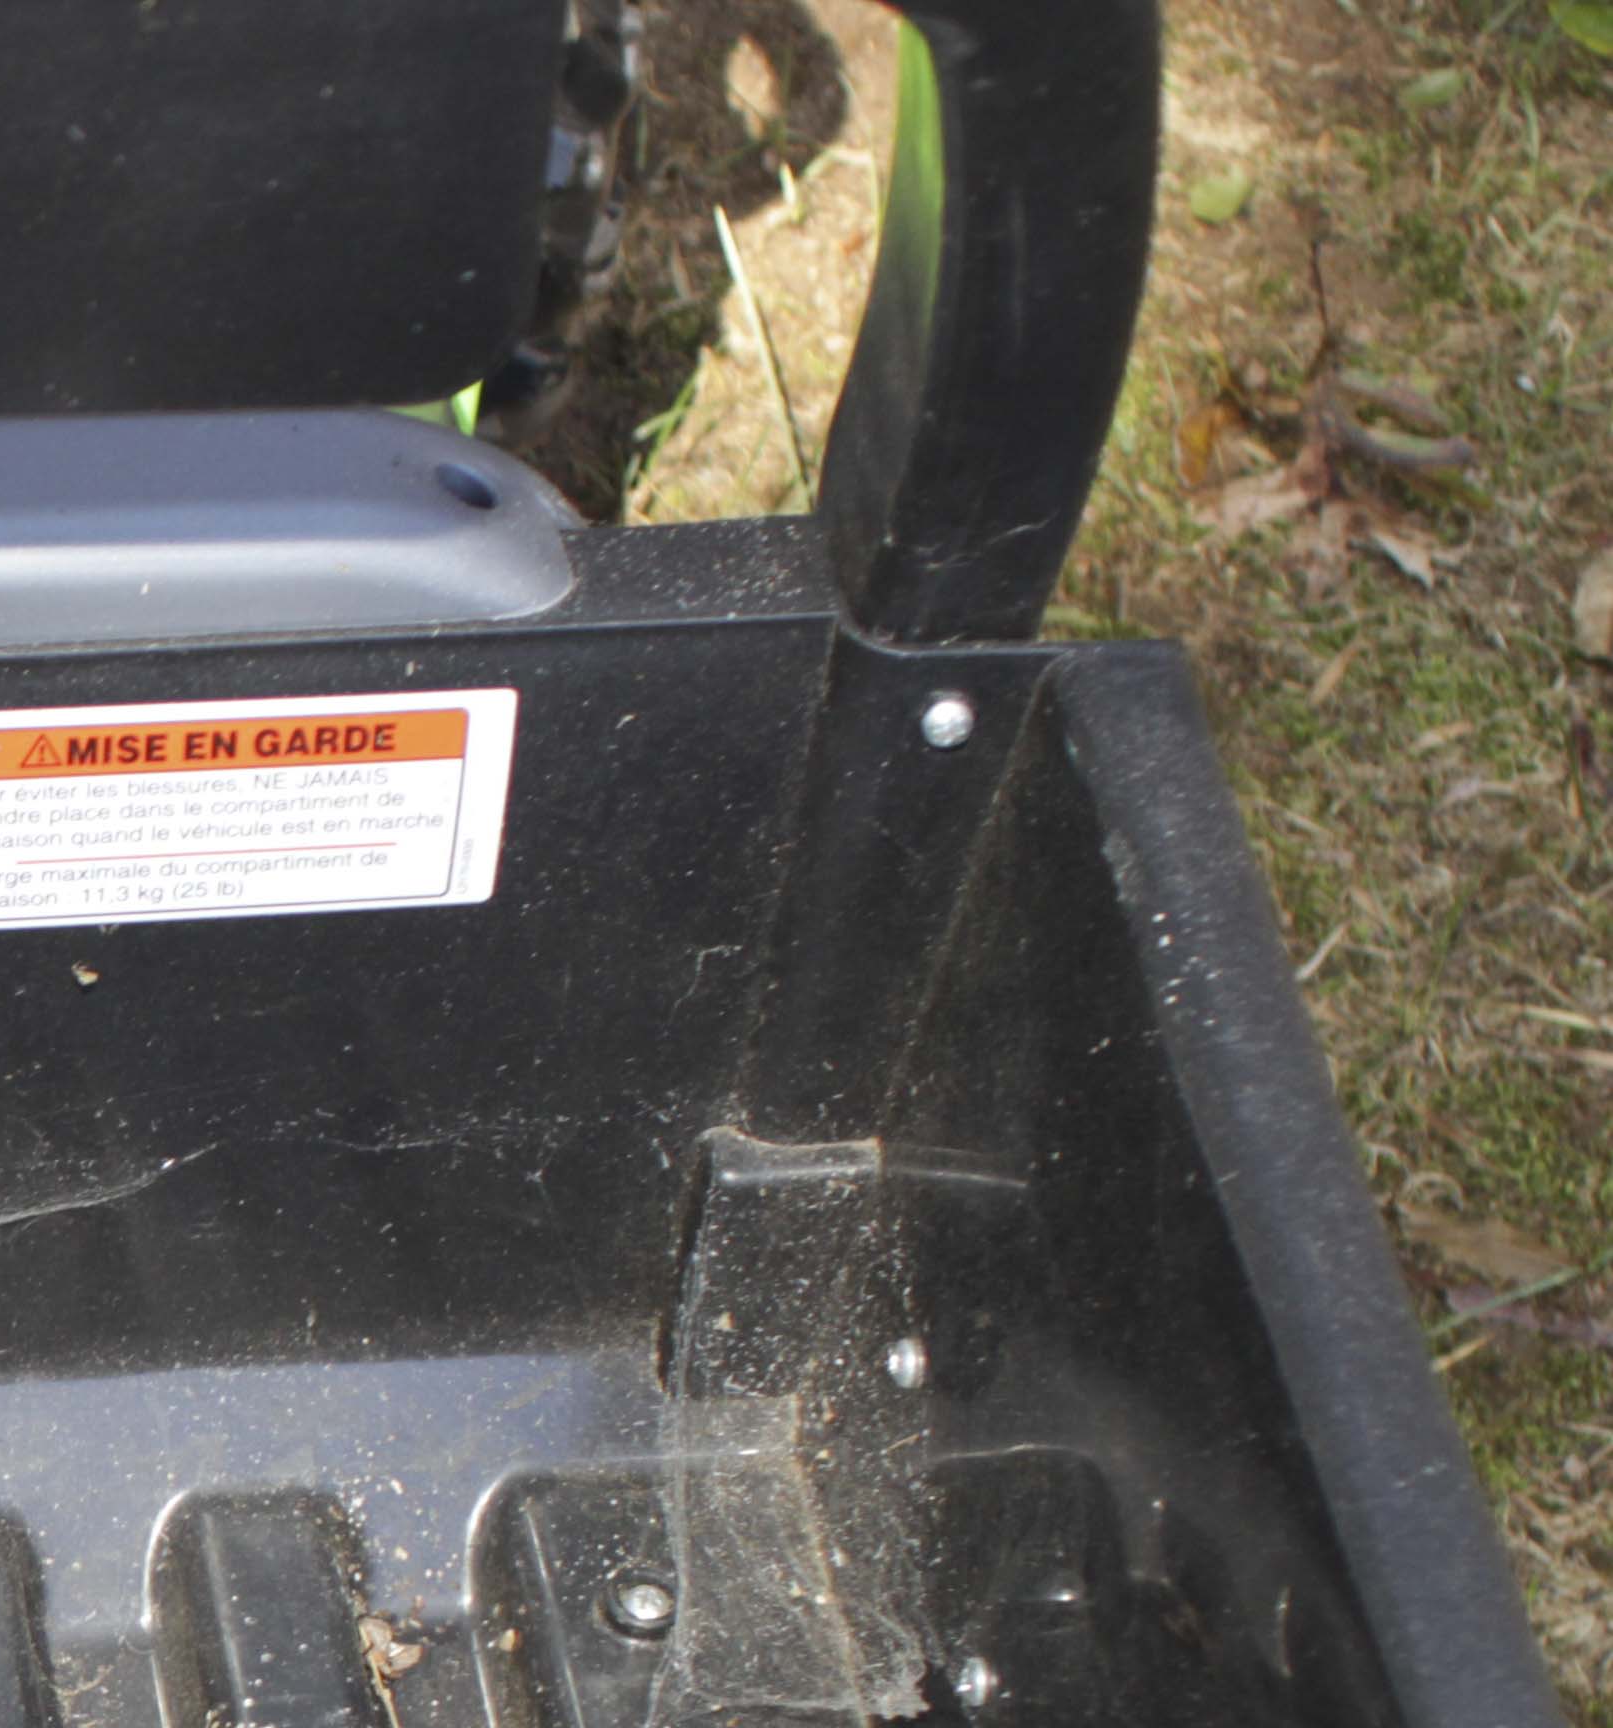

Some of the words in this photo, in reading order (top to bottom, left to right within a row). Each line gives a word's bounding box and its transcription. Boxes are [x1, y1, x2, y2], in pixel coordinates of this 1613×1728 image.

[66, 733, 166, 766] MISE
[185, 730, 238, 760] EN
[255, 722, 397, 757] GARDE
[14, 783, 76, 800] éviter
[86, 781, 118, 796] les
[252, 772, 287, 789] NE
[298, 768, 389, 788] JAMAIS
[49, 803, 111, 824] place
[118, 800, 175, 817] dans
[183, 799, 203, 814] le
[210, 792, 369, 816] compartiment
[376, 789, 405, 804] de
[70, 826, 143, 847] quand
[150, 825, 170, 840] le
[178, 819, 273, 838] véhicule
[280, 817, 314, 833] est
[322, 819, 351, 831] en
[358, 811, 446, 829] marche
[40, 861, 151, 881] maximale
[158, 859, 187, 875] du
[194, 853, 351, 876] compartiment
[359, 848, 389, 864] de
[137, 884, 165, 903] kg
[172, 882, 208, 902] (25
[216, 880, 246, 899] lb)
